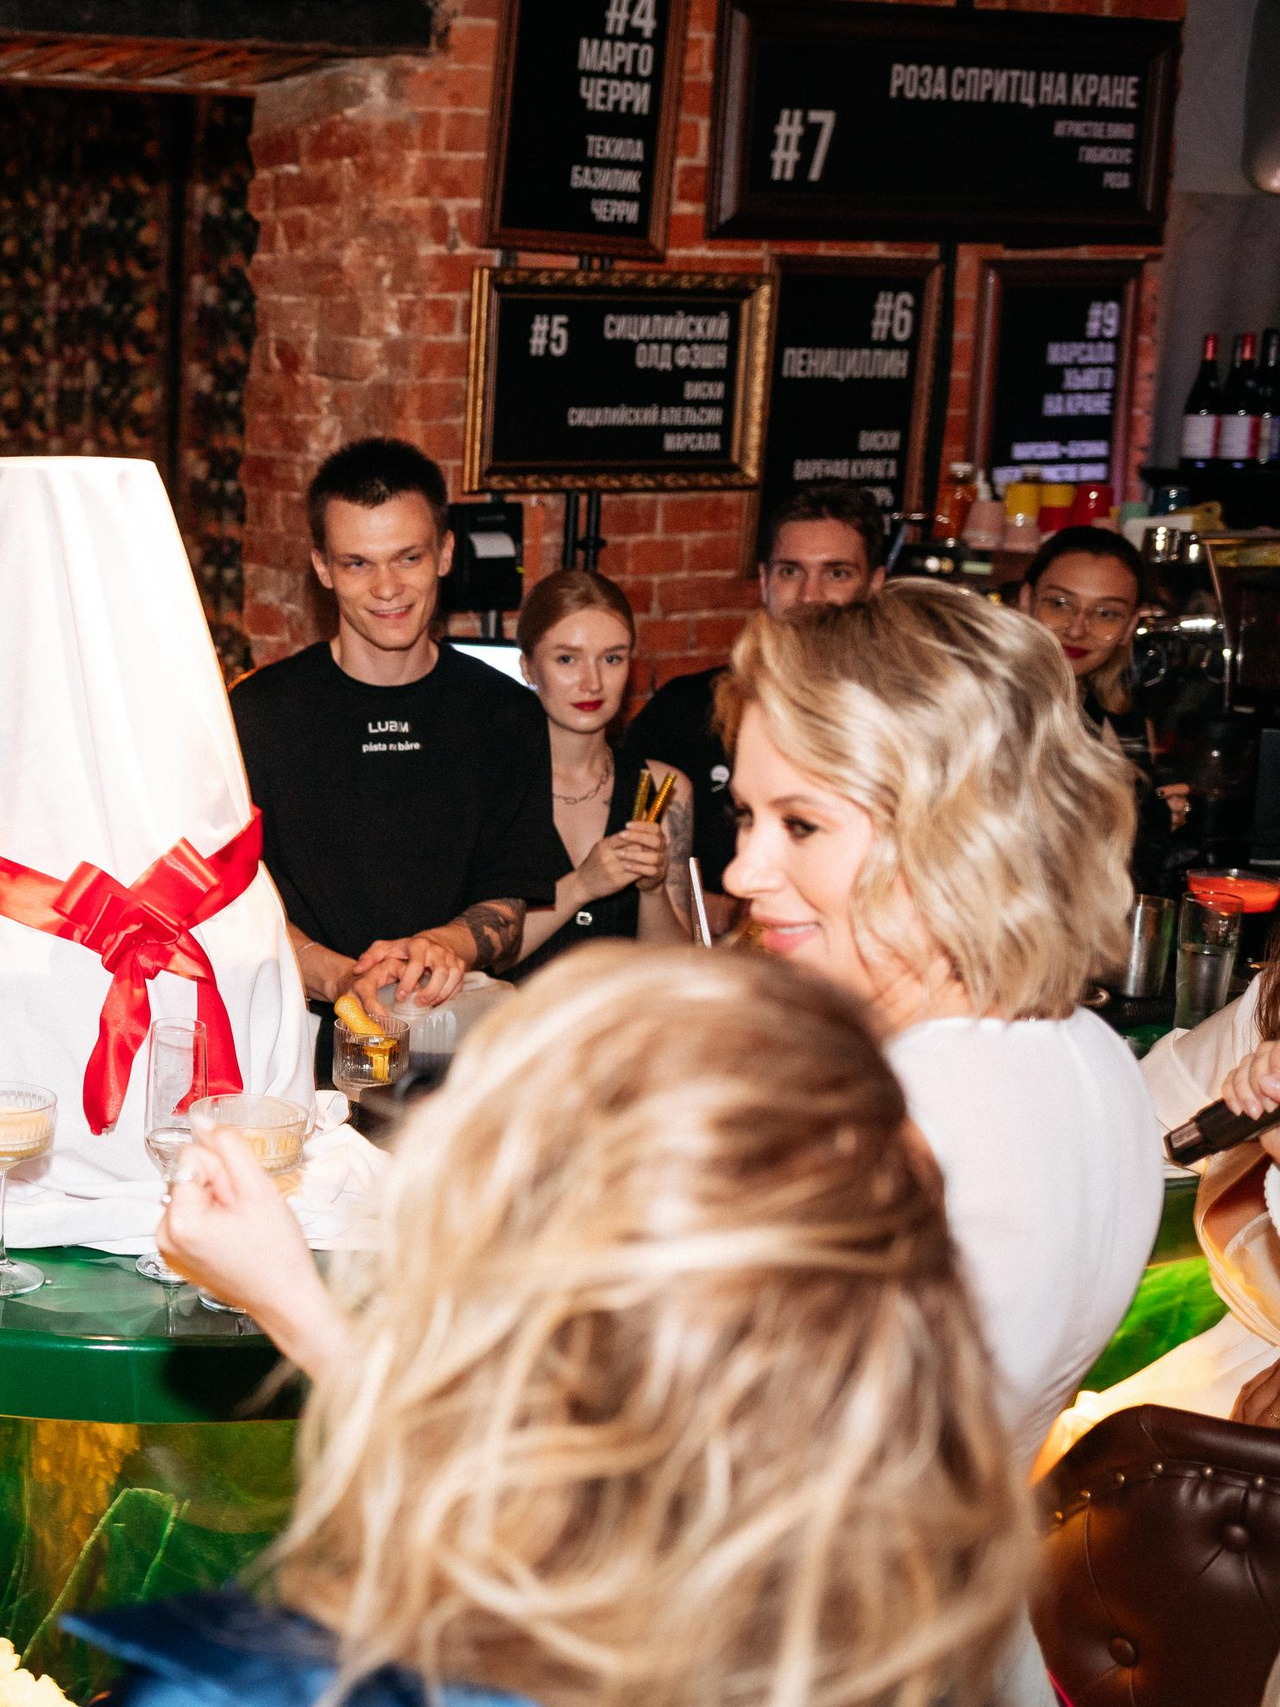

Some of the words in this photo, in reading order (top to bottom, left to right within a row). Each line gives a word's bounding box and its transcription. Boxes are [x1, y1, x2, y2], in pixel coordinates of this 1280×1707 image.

[605, 0, 656, 38] #4
[578, 37, 653, 77] МАРГО
[580, 76, 650, 115] ЧЕРРИ
[890, 64, 947, 100] РОЗА
[951, 66, 1036, 108] СПРИТЦ
[1039, 72, 1067, 105] НА
[1071, 74, 1139, 108] КРАНЕ
[771, 109, 835, 181] #7
[571, 165, 641, 192] БАЗИЛИК
[529, 315, 568, 356] #5
[604, 311, 729, 342] СИЦИЛИЙСКИЙ
[872, 292, 913, 341] #6
[1086, 302, 1119, 338] #9
